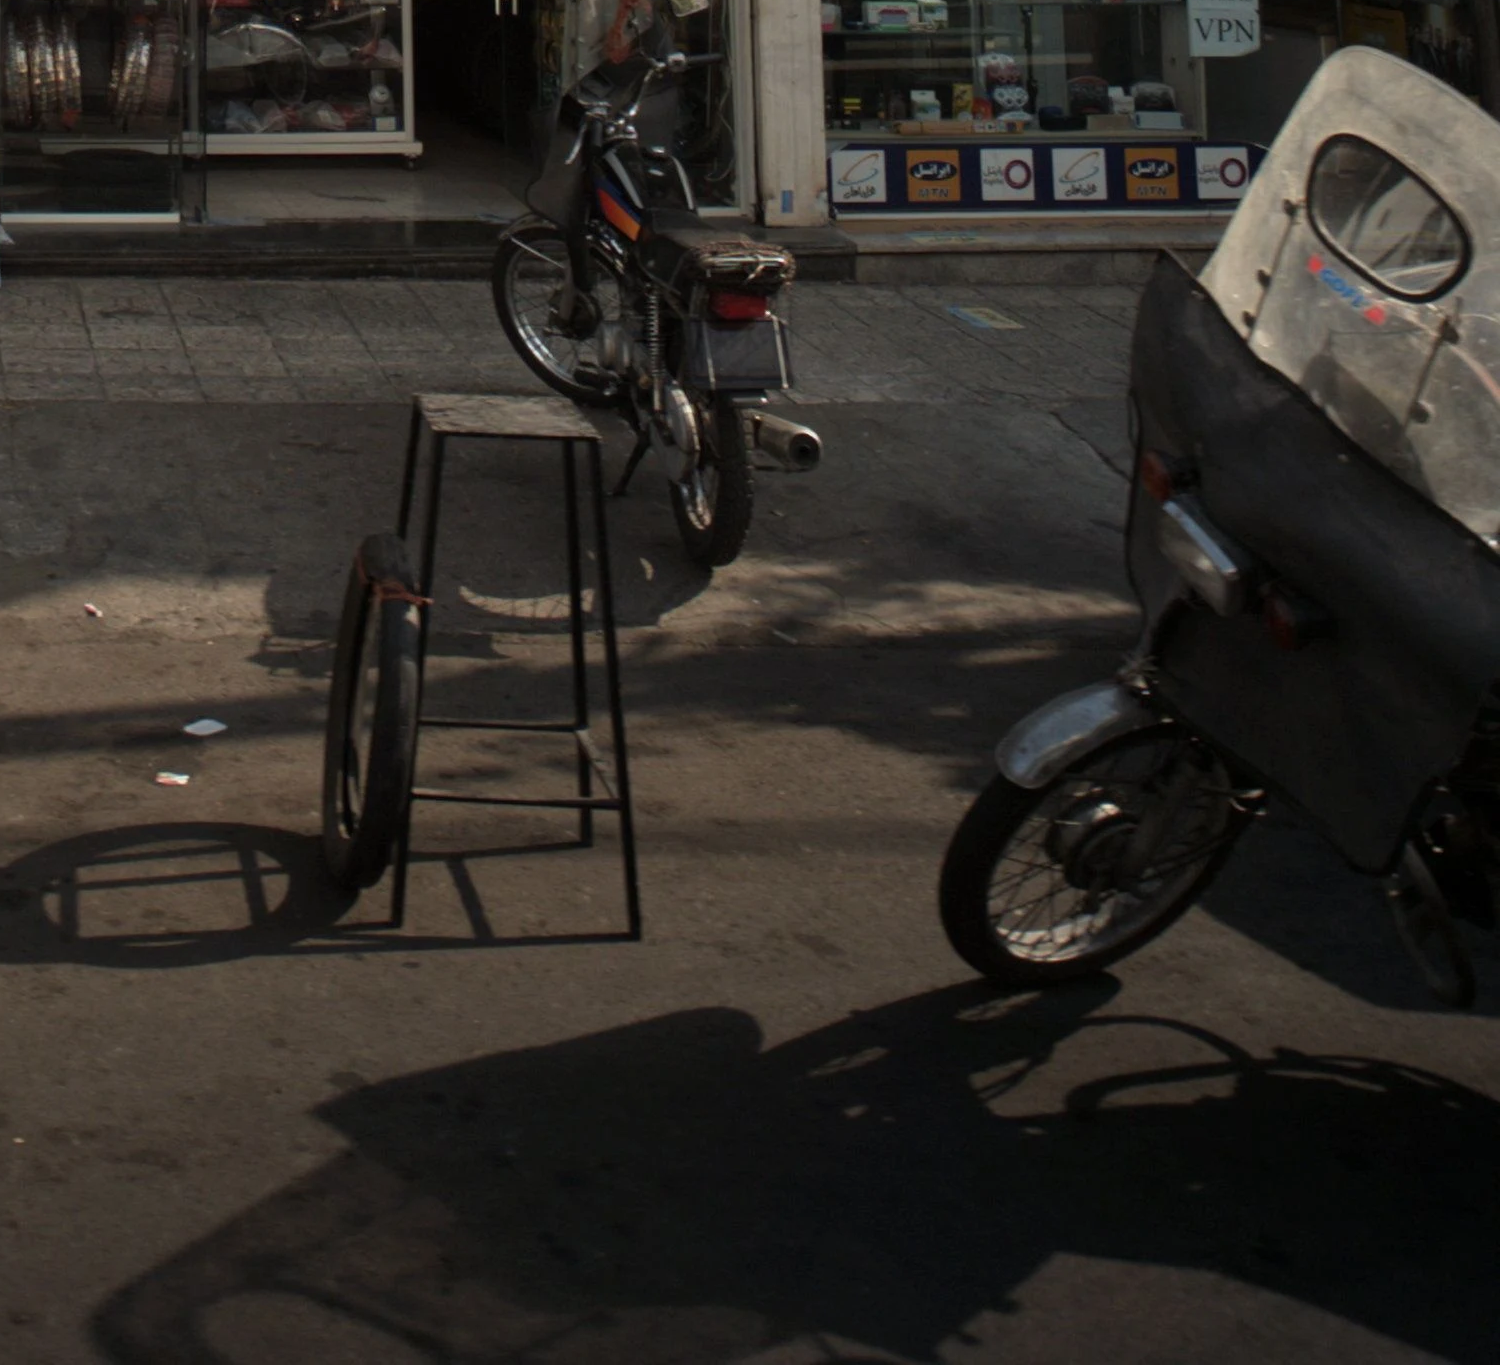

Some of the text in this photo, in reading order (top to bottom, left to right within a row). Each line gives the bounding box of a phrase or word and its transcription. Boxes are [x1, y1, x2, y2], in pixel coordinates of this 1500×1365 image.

[1196, 18, 1255, 43] VPN
[913, 161, 952, 178] ایرانسل
[1132, 160, 1171, 177] ایرانسل
[917, 187, 950, 199] MTN
[1136, 185, 1168, 197] MTN
